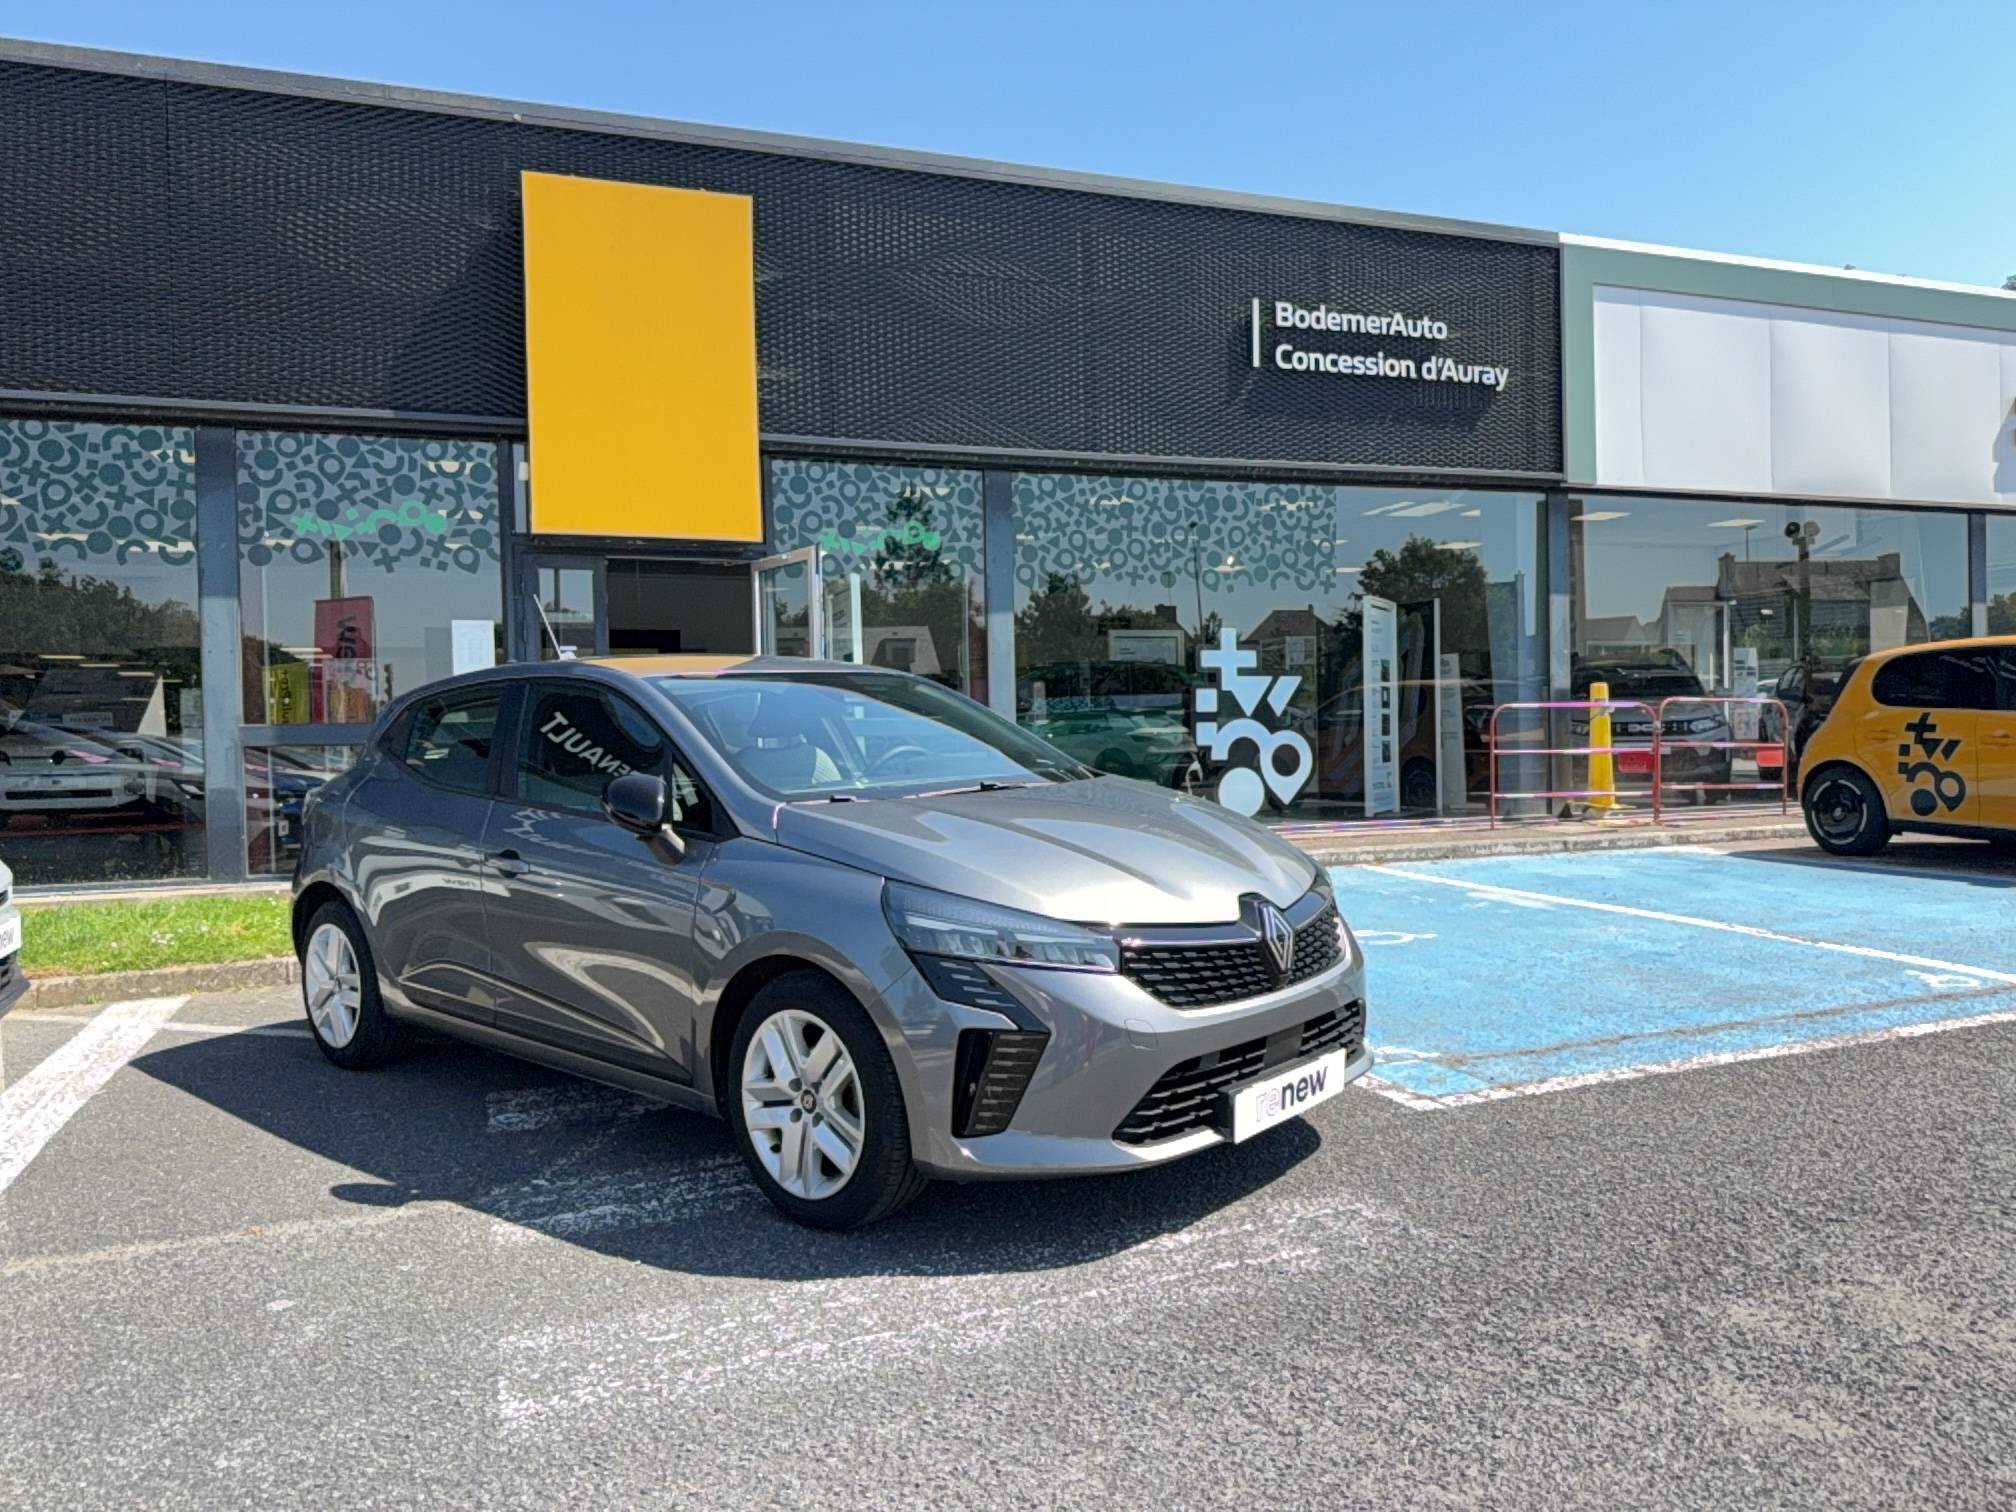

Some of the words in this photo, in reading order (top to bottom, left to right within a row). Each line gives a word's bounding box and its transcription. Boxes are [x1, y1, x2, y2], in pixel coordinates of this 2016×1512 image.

[1275, 301, 1448, 339] BodemerAuto
[1275, 344, 1417, 379] Concession
[1421, 356, 1509, 391] d'Auray
[1255, 1066, 1328, 1122] renew
